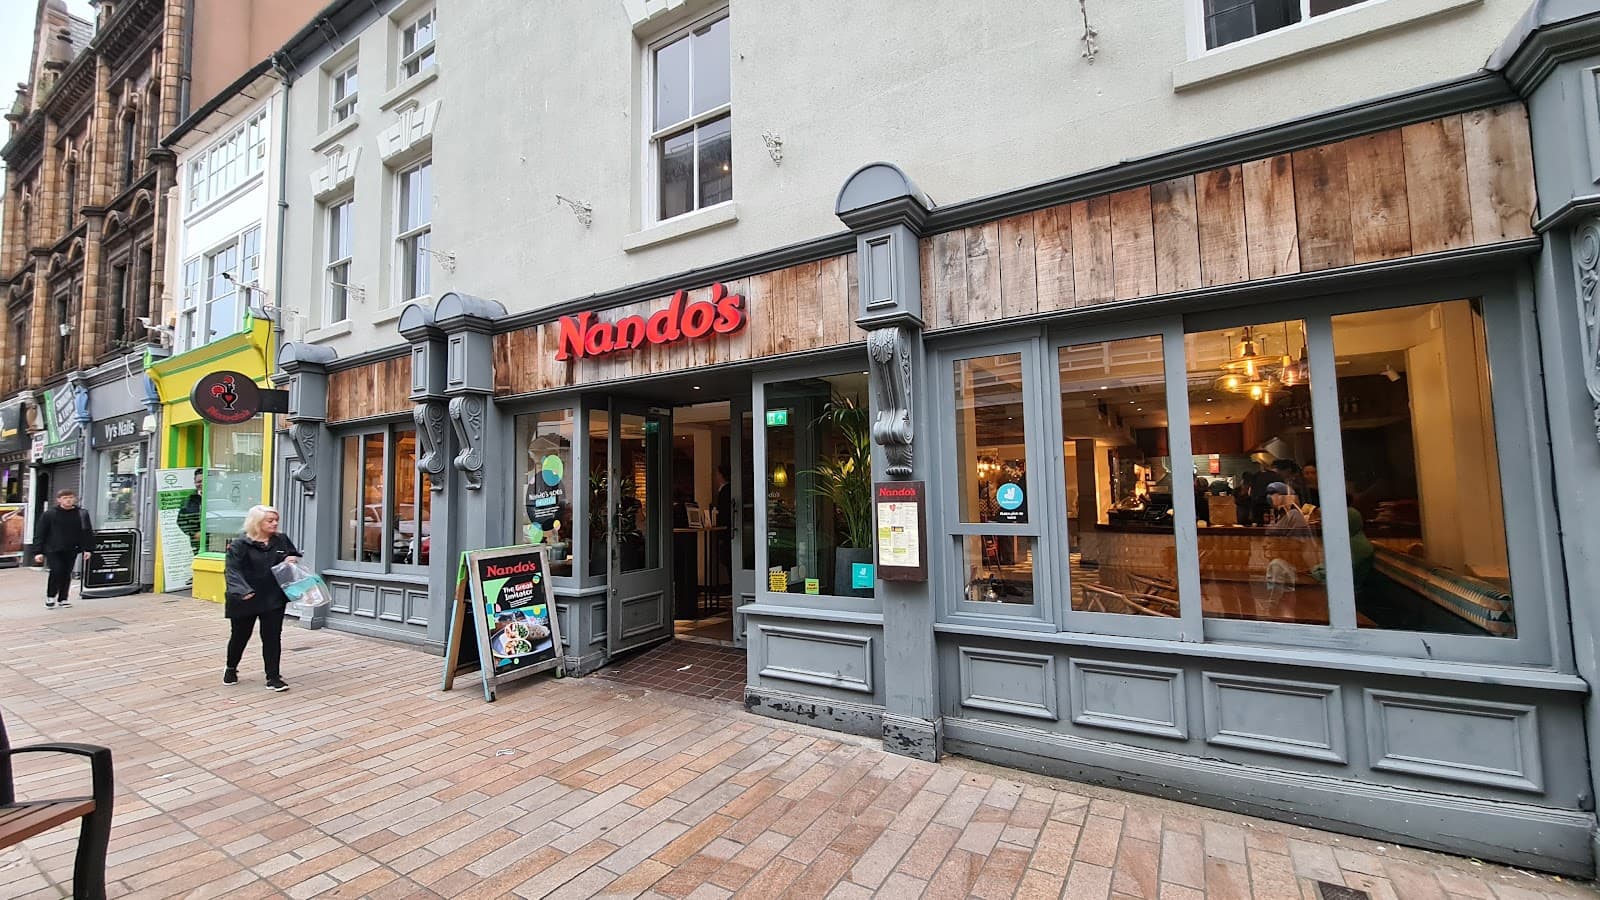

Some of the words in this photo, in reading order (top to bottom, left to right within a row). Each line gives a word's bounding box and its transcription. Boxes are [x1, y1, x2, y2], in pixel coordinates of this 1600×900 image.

[555, 282, 746, 361] Nando's
[105, 423, 118, 442] Vy's
[118, 419, 136, 436] Nails
[879, 487, 916, 497] Nando's
[486, 561, 536, 578] Nando's
[502, 585, 515, 594] The
[514, 581, 534, 592] Great
